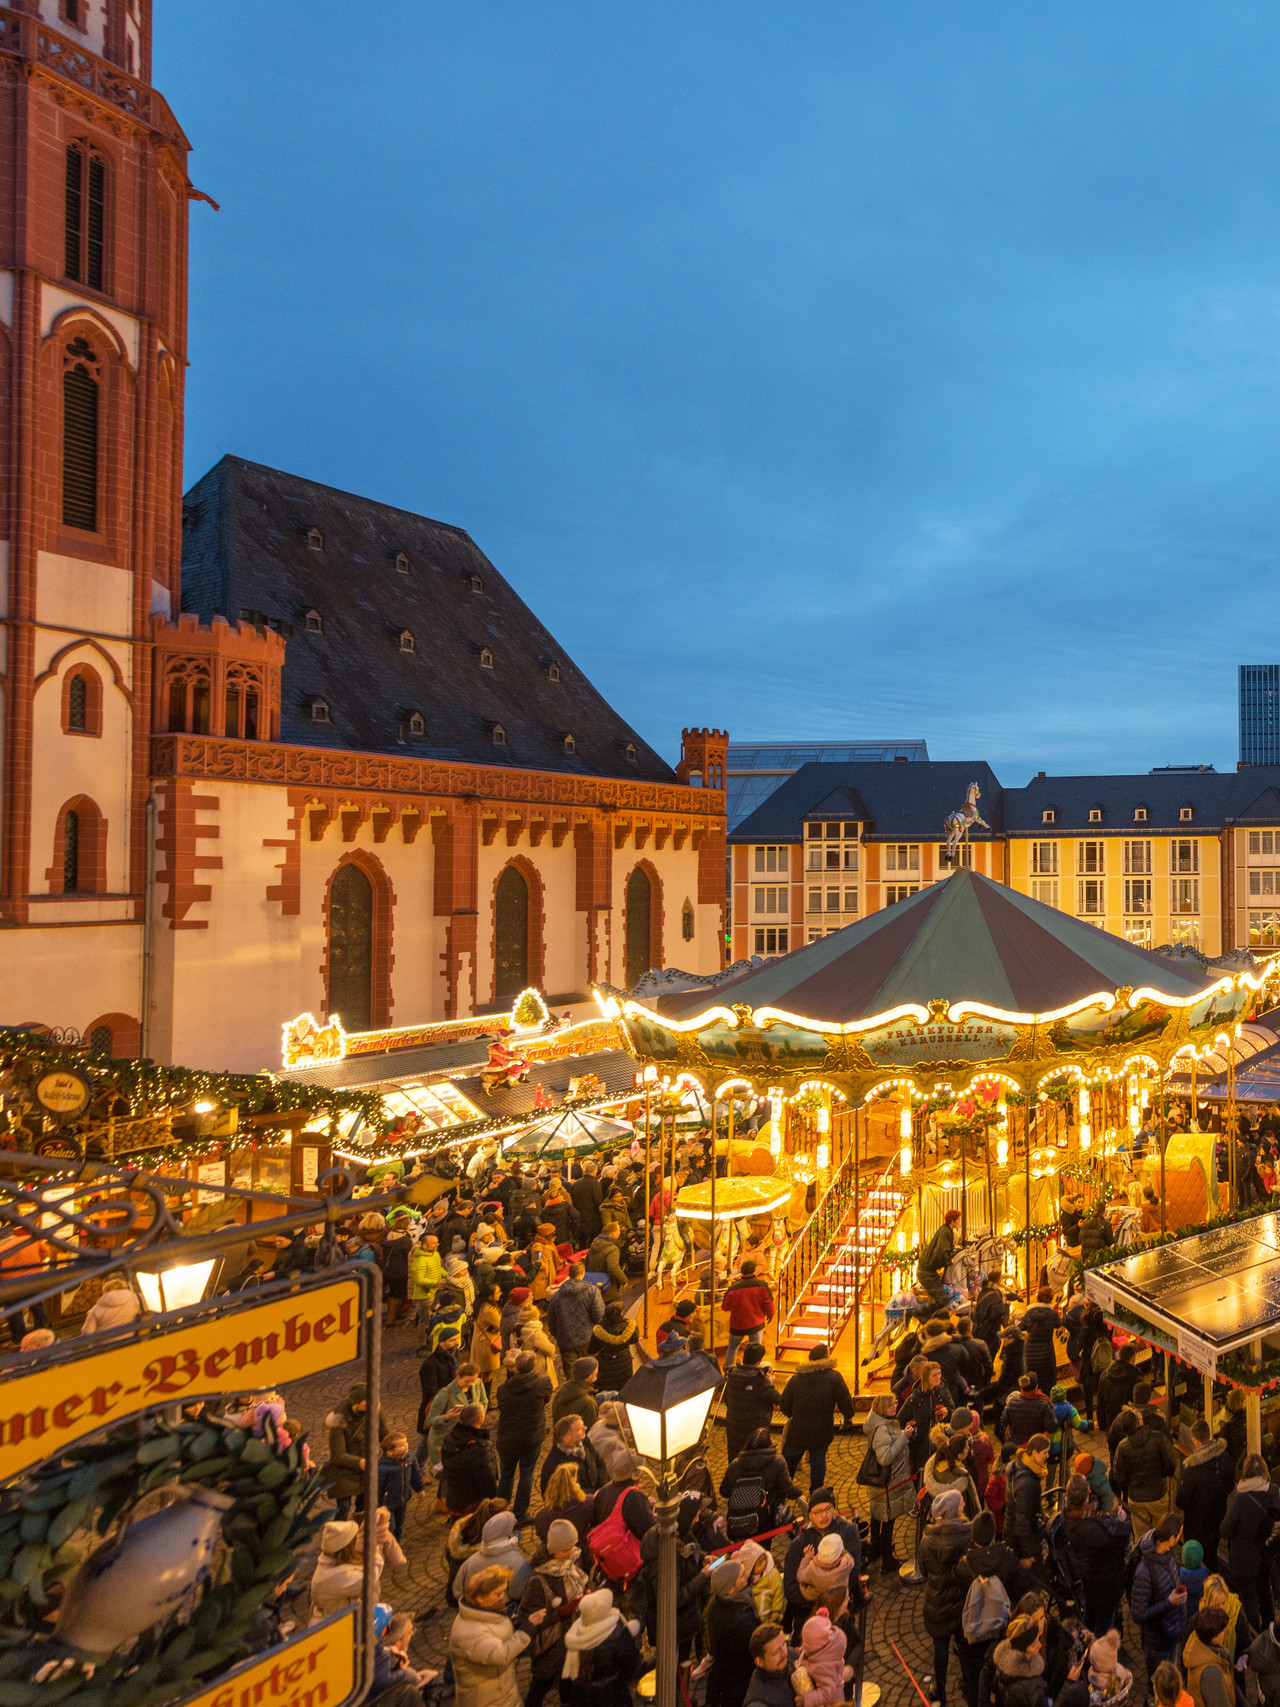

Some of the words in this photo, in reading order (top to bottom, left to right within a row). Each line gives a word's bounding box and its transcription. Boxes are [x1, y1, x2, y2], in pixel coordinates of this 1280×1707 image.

[886, 1026, 994, 1039] FRANKFURTER
[350, 1033, 420, 1053] Frankfurter
[899, 1034, 981, 1047] KARUSSELL
[525, 1039, 584, 1060] Frankfurter
[43, 1145, 77, 1159] Raclette
